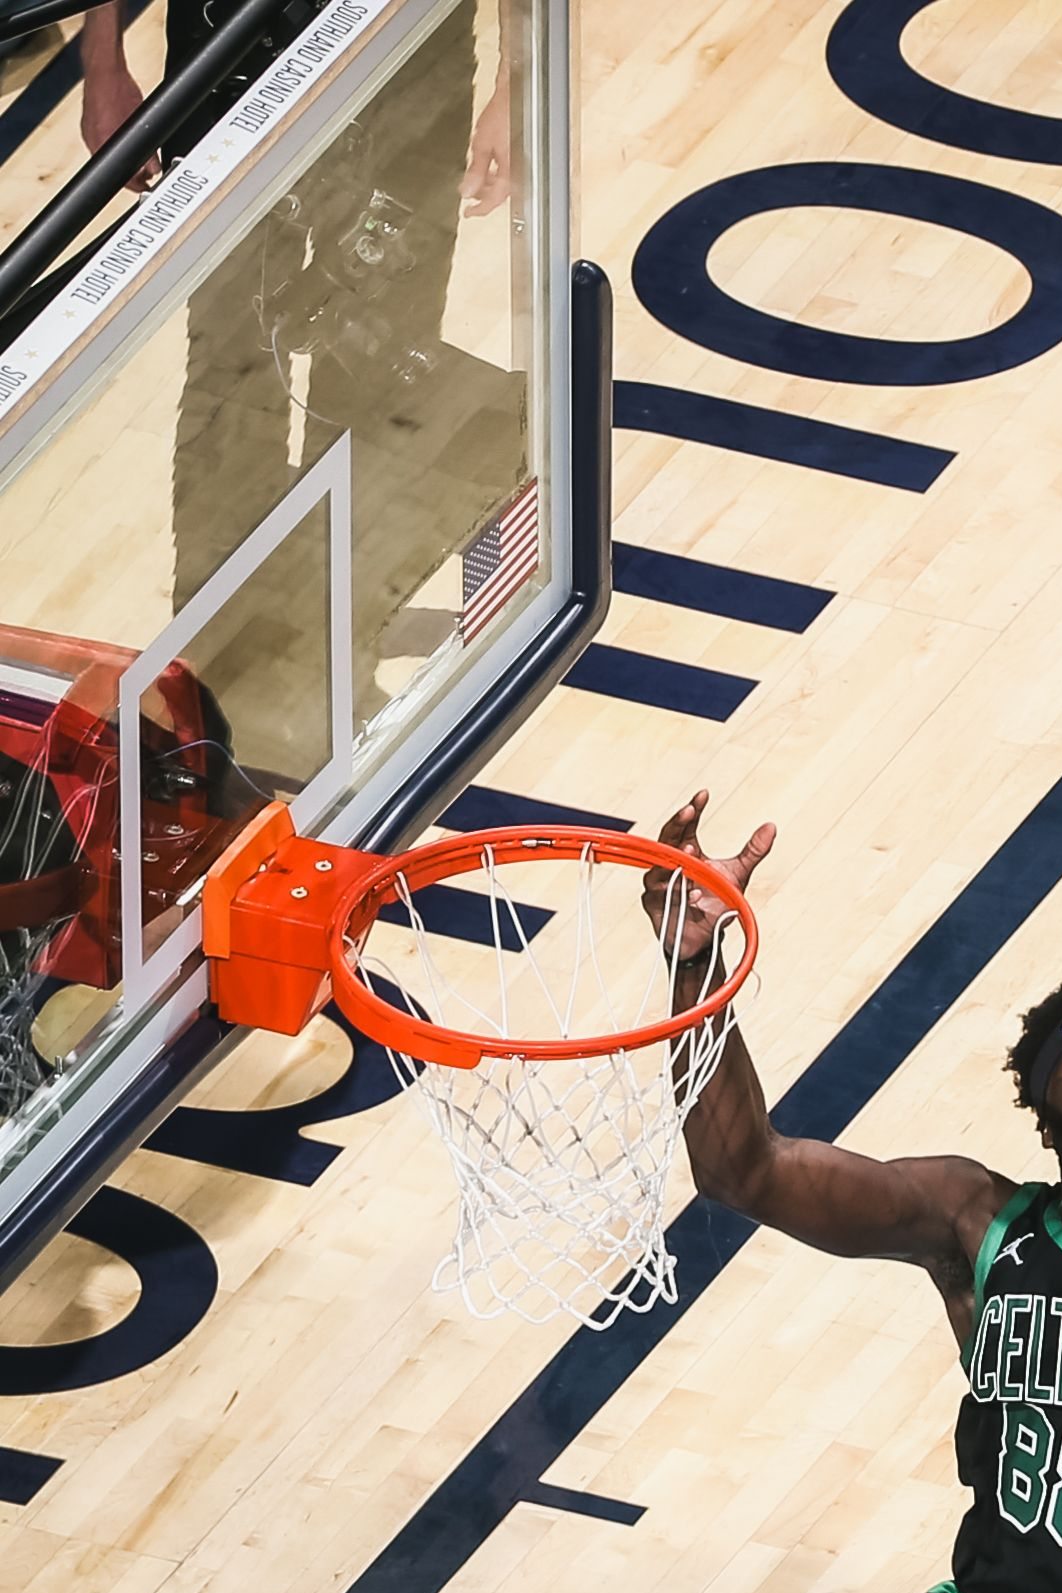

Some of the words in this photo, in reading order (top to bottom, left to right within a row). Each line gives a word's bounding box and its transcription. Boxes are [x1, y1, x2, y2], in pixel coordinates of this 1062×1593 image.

[297, 0, 368, 63] SOUTHLAND
[259, 58, 313, 104] CASINO
[229, 98, 277, 134] HOTEL
[138, 169, 208, 234] SOUTHLAND
[100, 229, 154, 275] CASINO
[70, 269, 119, 305] HOTEL
